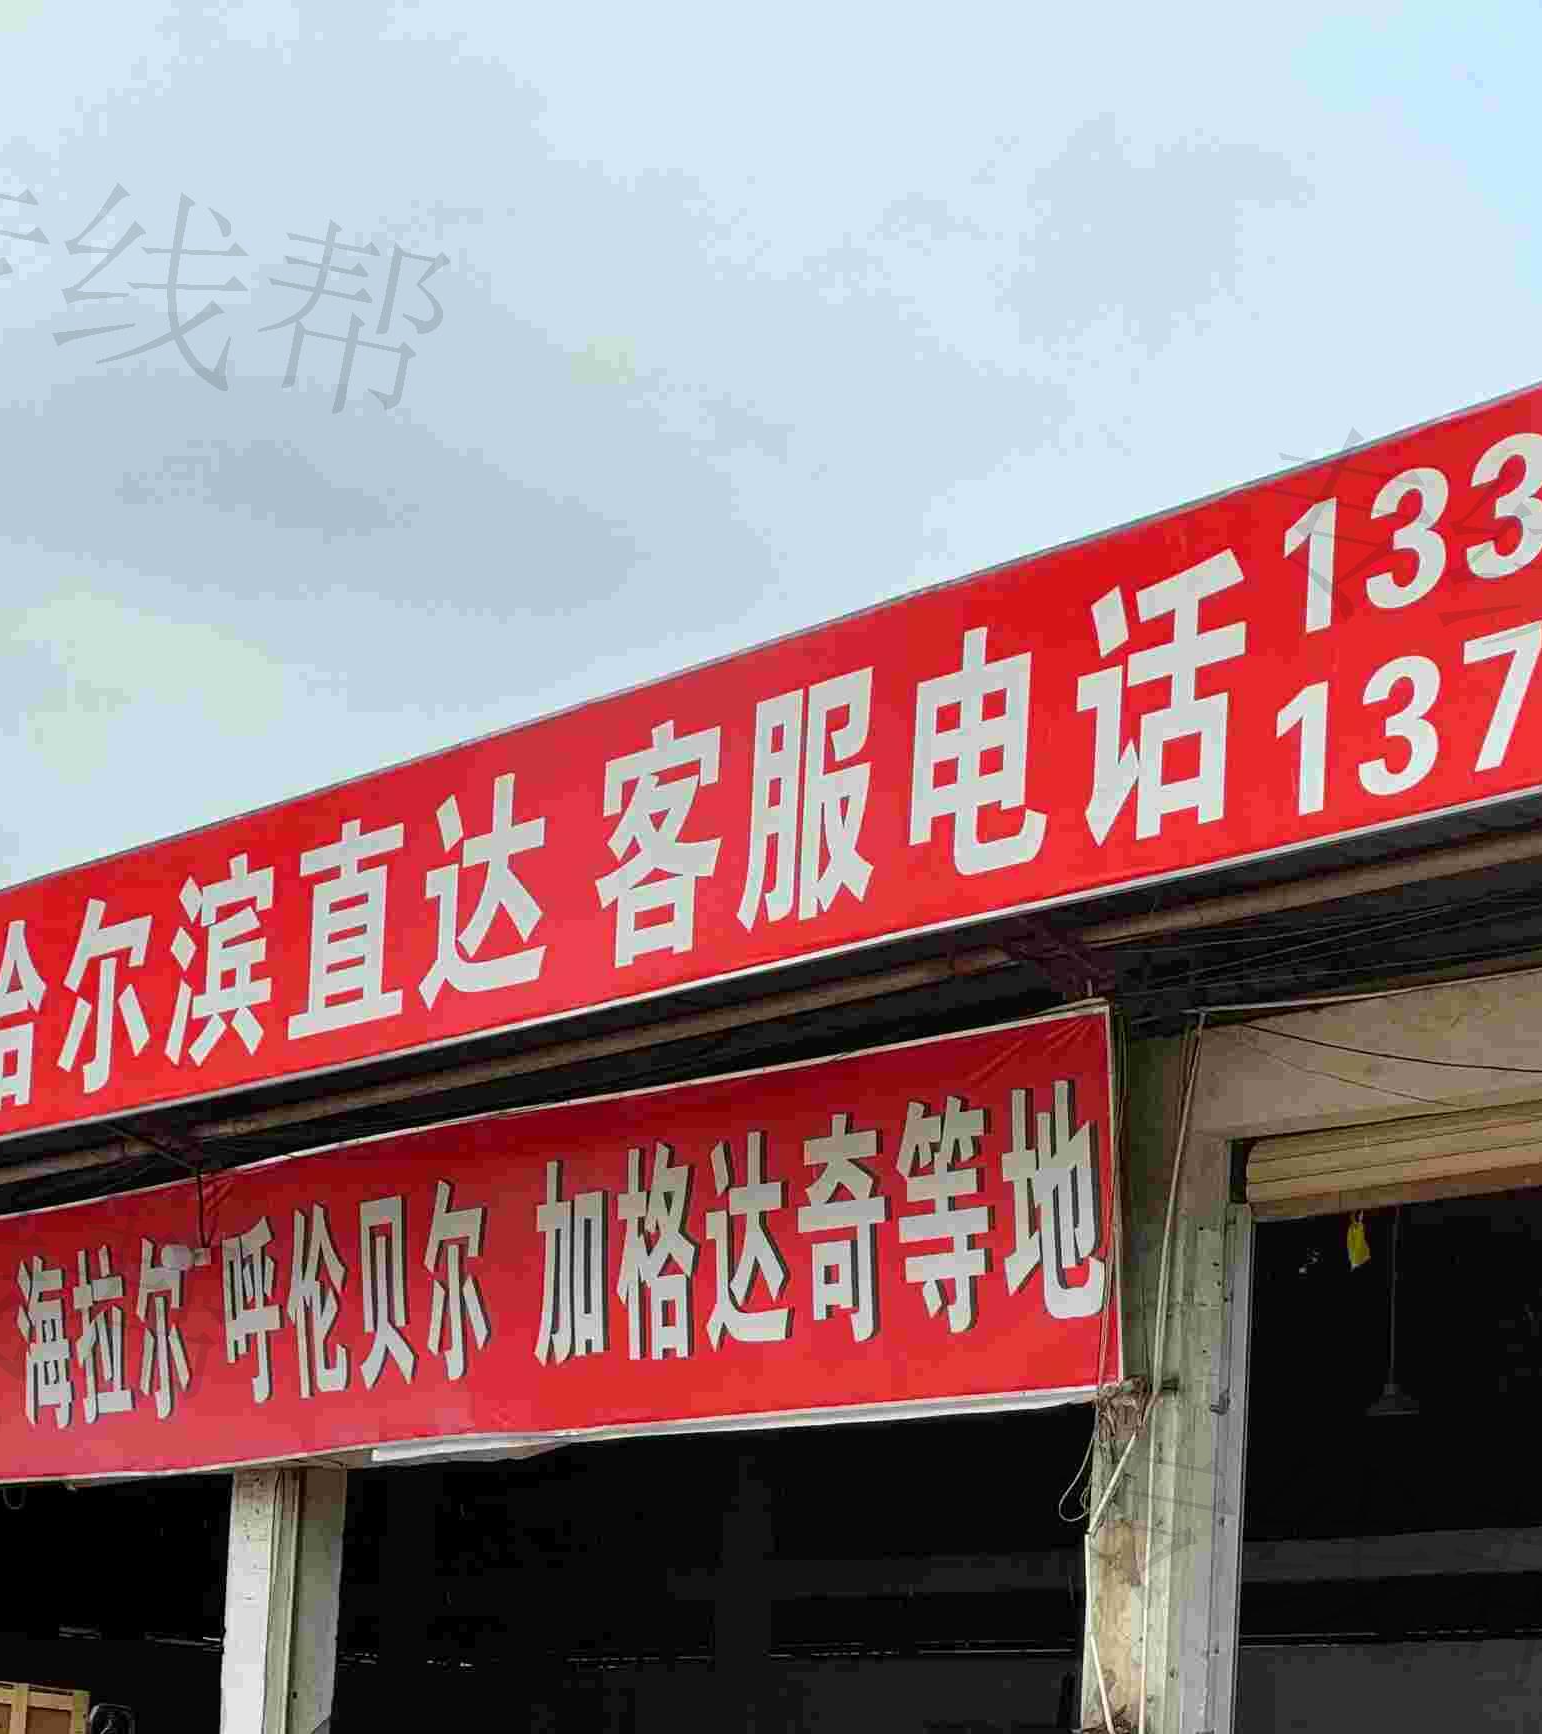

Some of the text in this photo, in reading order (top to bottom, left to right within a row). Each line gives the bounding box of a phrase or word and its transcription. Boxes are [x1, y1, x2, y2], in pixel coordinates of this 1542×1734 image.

[595, 547, 1248, 970] 客服电话
[16, 1234, 195, 1428] 海拉尔
[220, 1180, 491, 1404] 呼伦贝尔
[533, 1080, 1106, 1368] 加格达奇等地
